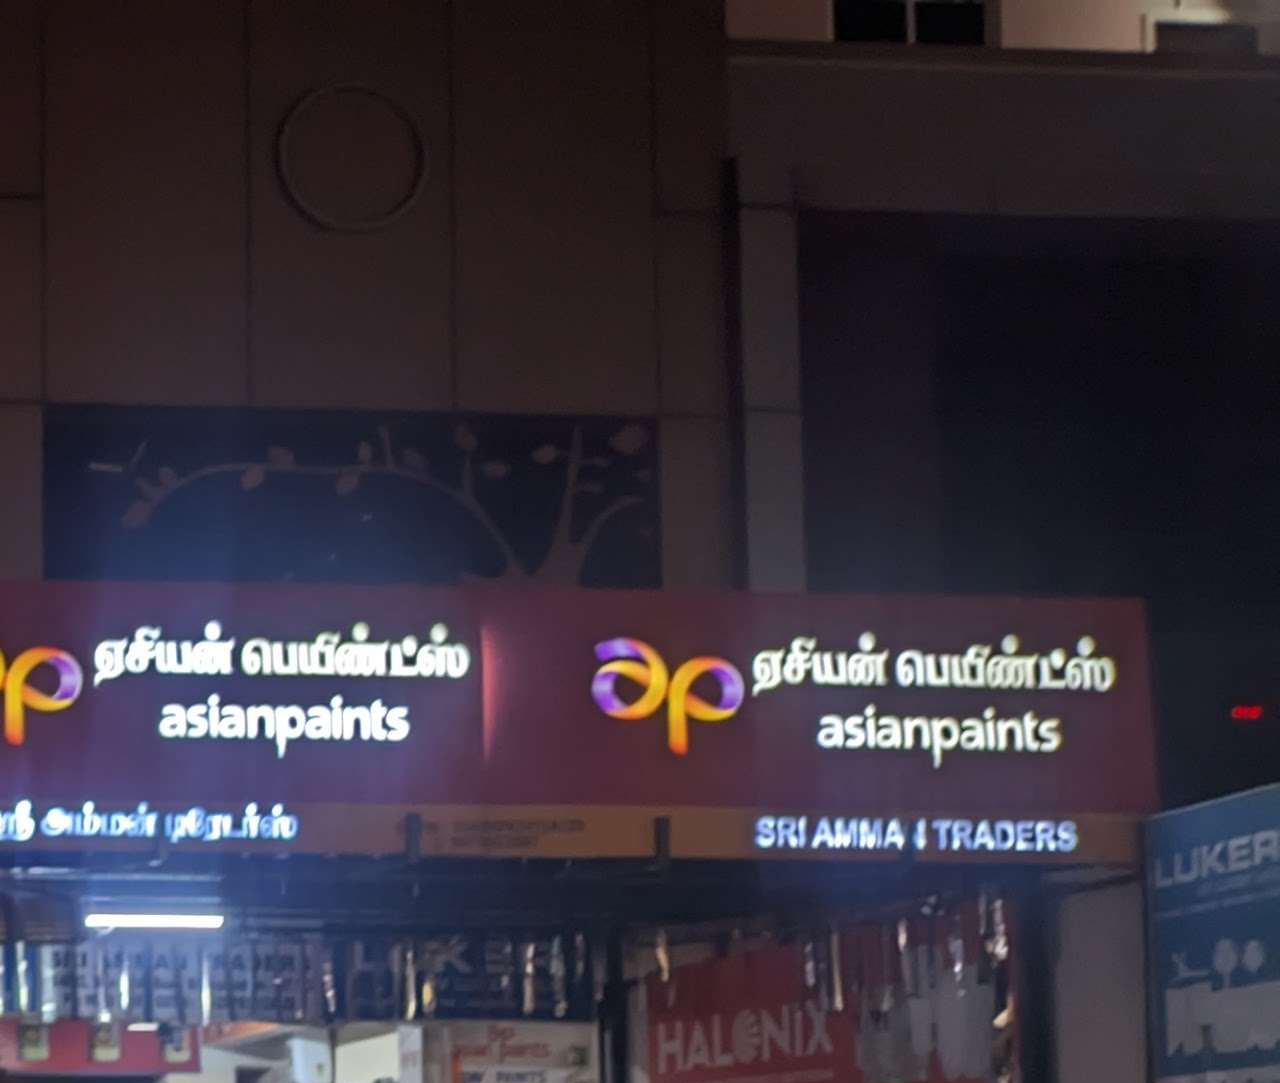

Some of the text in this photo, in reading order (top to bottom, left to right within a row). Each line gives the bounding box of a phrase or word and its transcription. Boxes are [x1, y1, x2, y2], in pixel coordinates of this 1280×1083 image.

[159, 693, 410, 758] asianpaints
[816, 704, 1062, 767] asianpaints
[754, 815, 807, 850] SRI
[932, 817, 1080, 853] TRADERS
